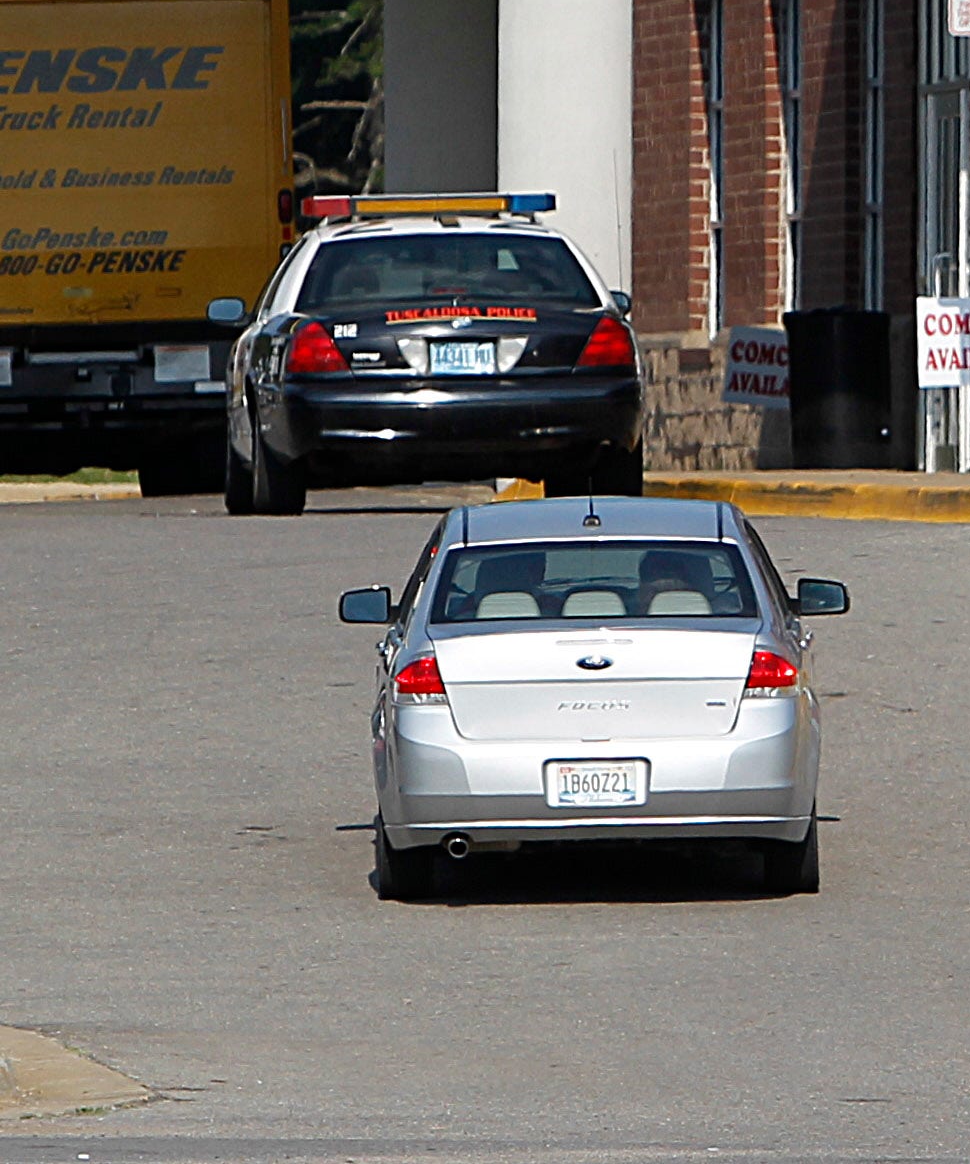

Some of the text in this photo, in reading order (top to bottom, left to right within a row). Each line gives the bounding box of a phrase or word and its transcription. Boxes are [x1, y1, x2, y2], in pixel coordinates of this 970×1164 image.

[66, 102, 161, 129] Rental
[39, 168, 56, 189] &
[61, 166, 154, 188] Business
[158, 165, 235, 185] Rentals
[2, 225, 169, 251] GoPenske.com
[385, 306, 536, 321] TUSCALOOSA POLICE
